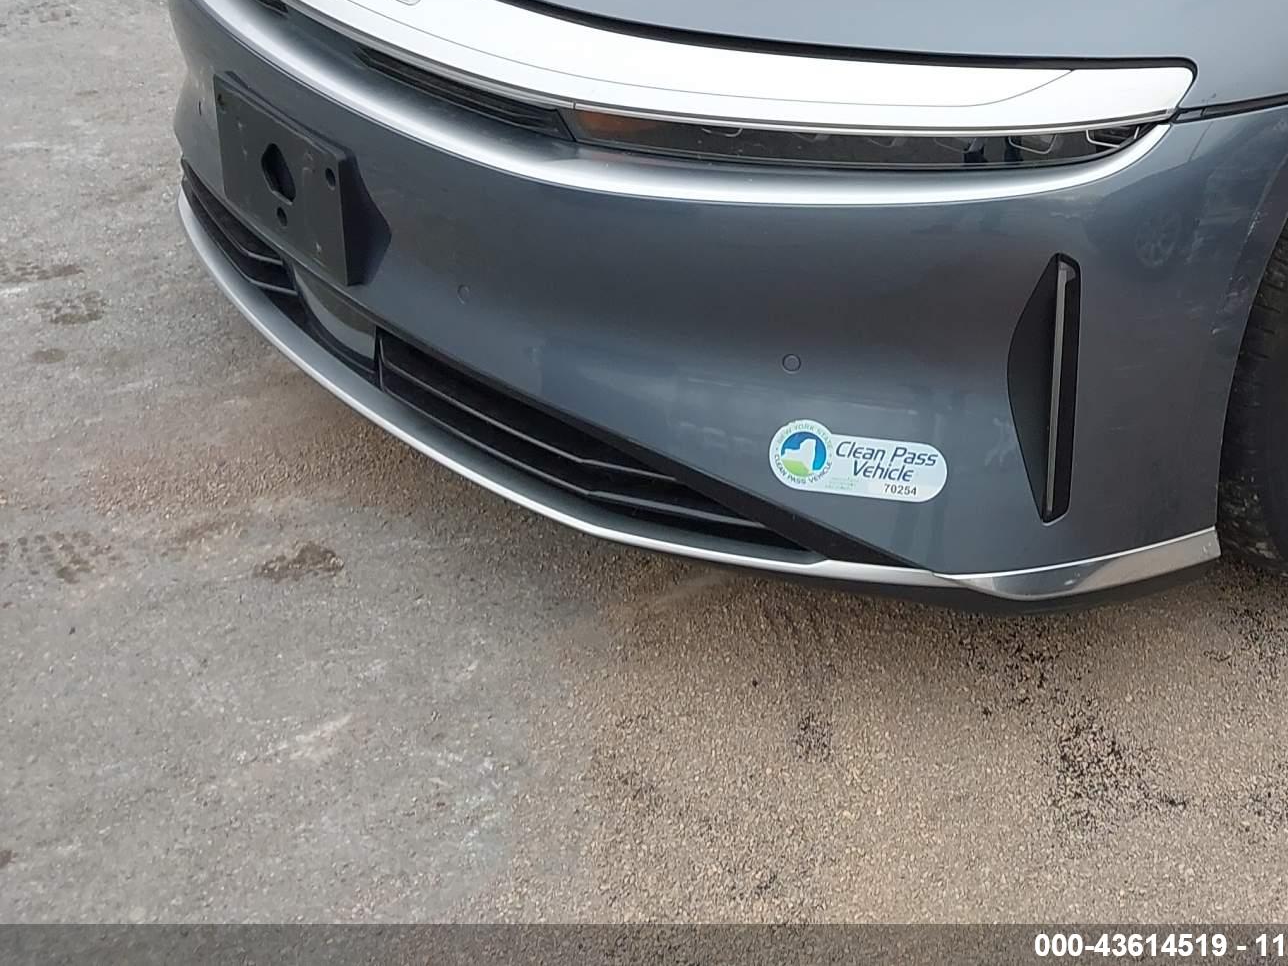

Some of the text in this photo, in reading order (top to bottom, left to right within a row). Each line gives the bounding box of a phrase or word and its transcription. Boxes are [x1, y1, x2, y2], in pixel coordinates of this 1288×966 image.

[836, 441, 939, 467] Clean Pass
[852, 460, 914, 482] Vehicle
[884, 484, 917, 496] 70254
